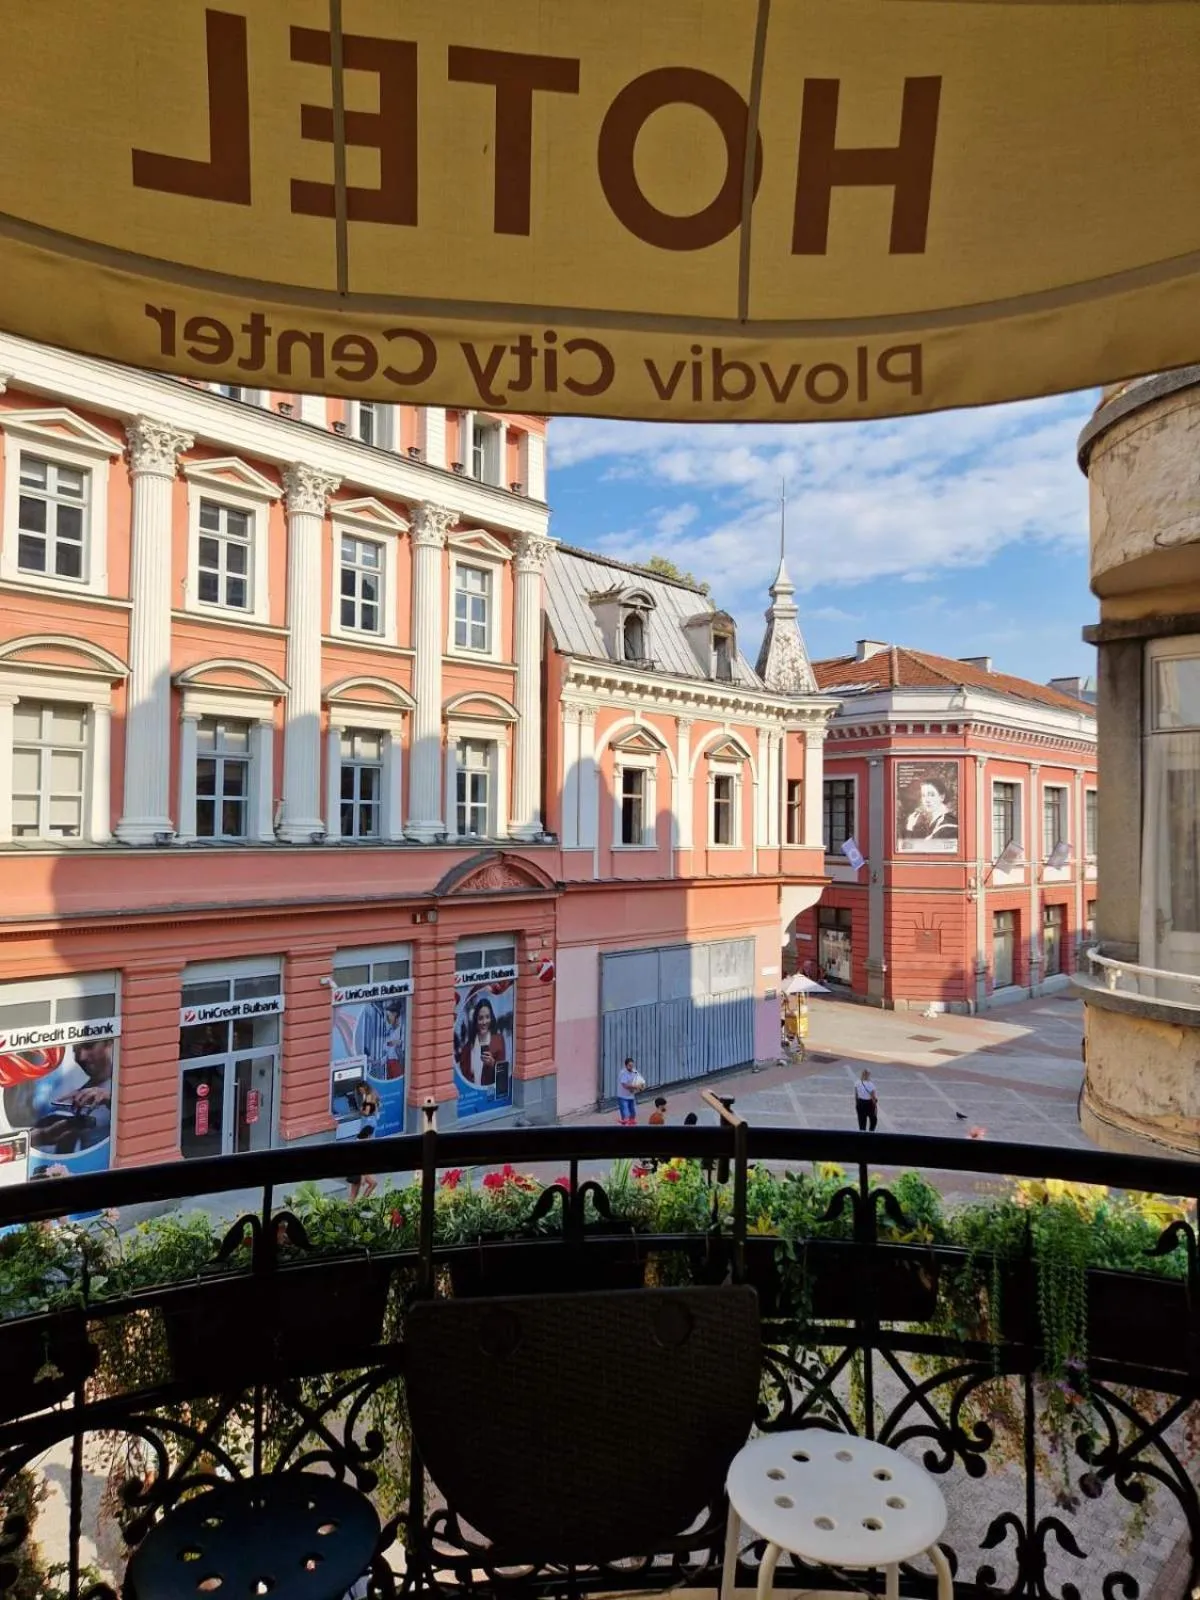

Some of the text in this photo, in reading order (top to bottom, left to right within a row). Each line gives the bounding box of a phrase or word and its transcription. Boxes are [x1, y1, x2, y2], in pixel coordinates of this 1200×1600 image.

[345, 984, 409, 1000] UniCredit Bulbank
[198, 1000, 279, 1021] UniCredit Bulbank
[9, 1022, 114, 1047] UniCredit Bulbank
